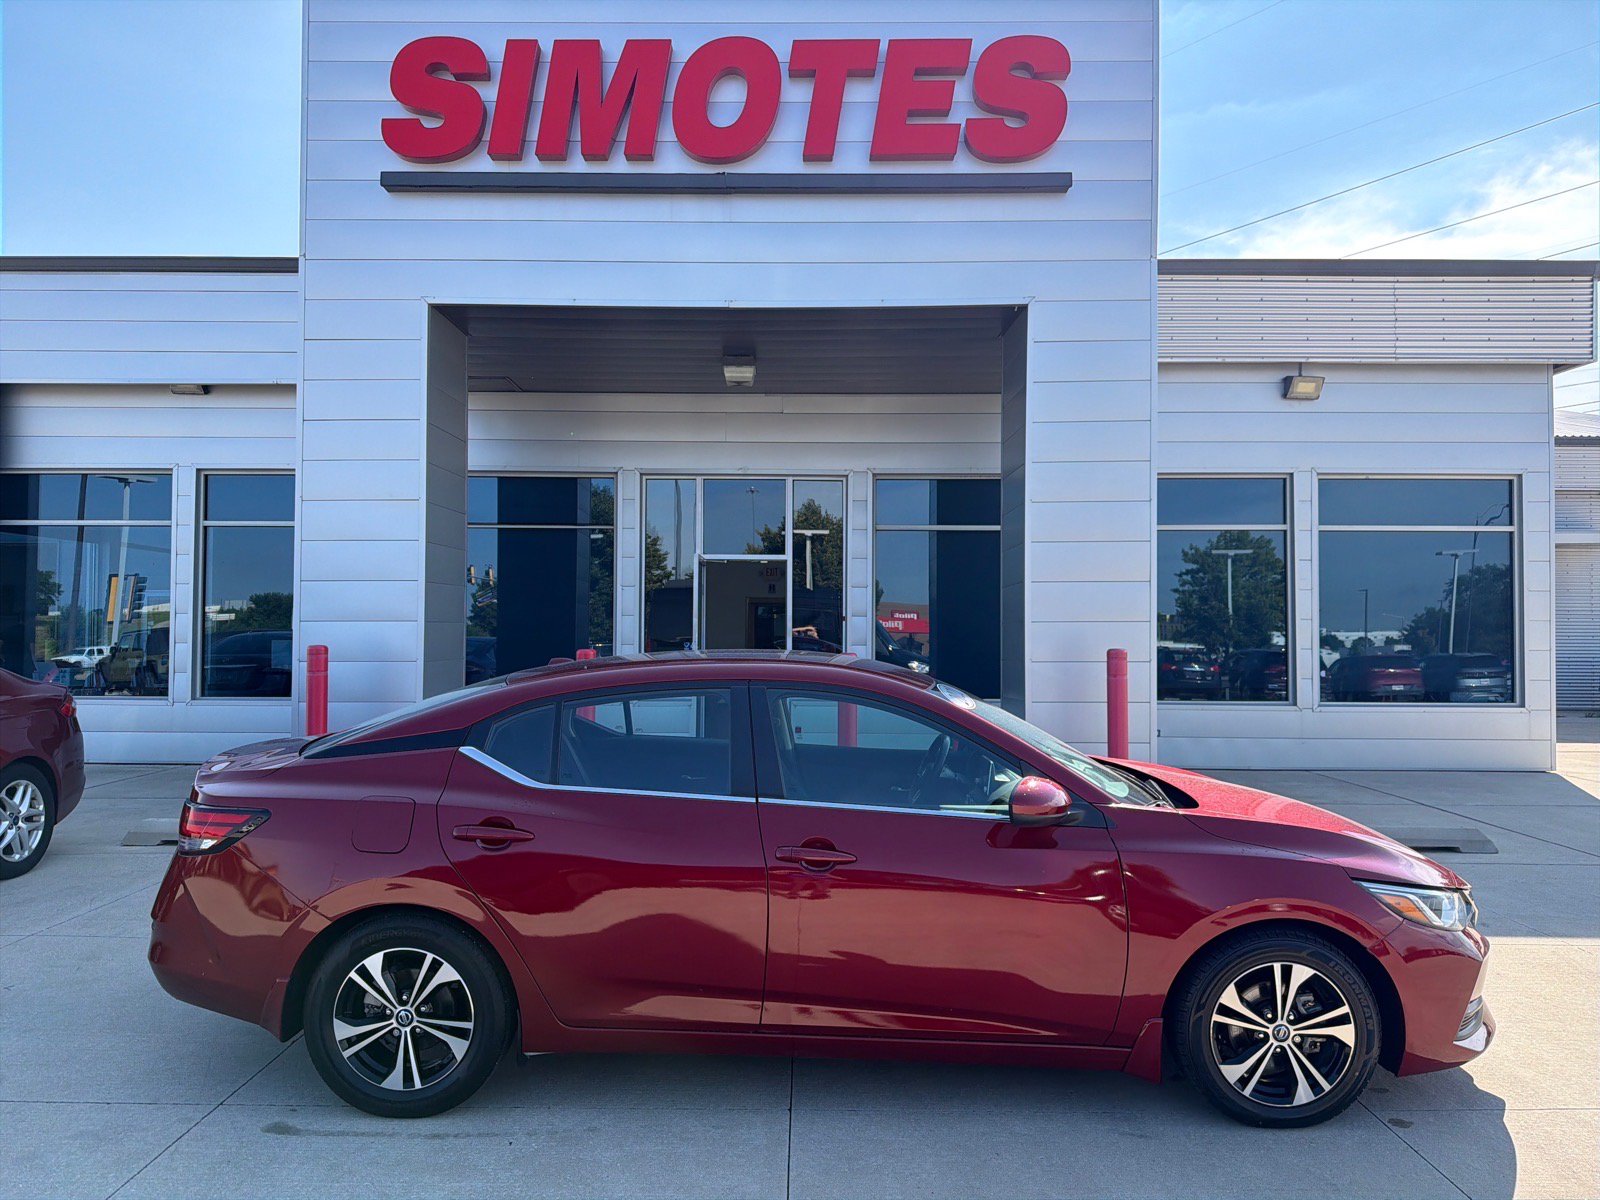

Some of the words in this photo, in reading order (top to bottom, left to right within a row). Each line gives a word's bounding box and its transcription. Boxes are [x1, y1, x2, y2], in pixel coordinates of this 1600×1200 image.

[381, 36, 1072, 163] SIMOTES
[765, 567, 778, 577] EXIT
[1328, 961, 1374, 1030] IRONMAN
